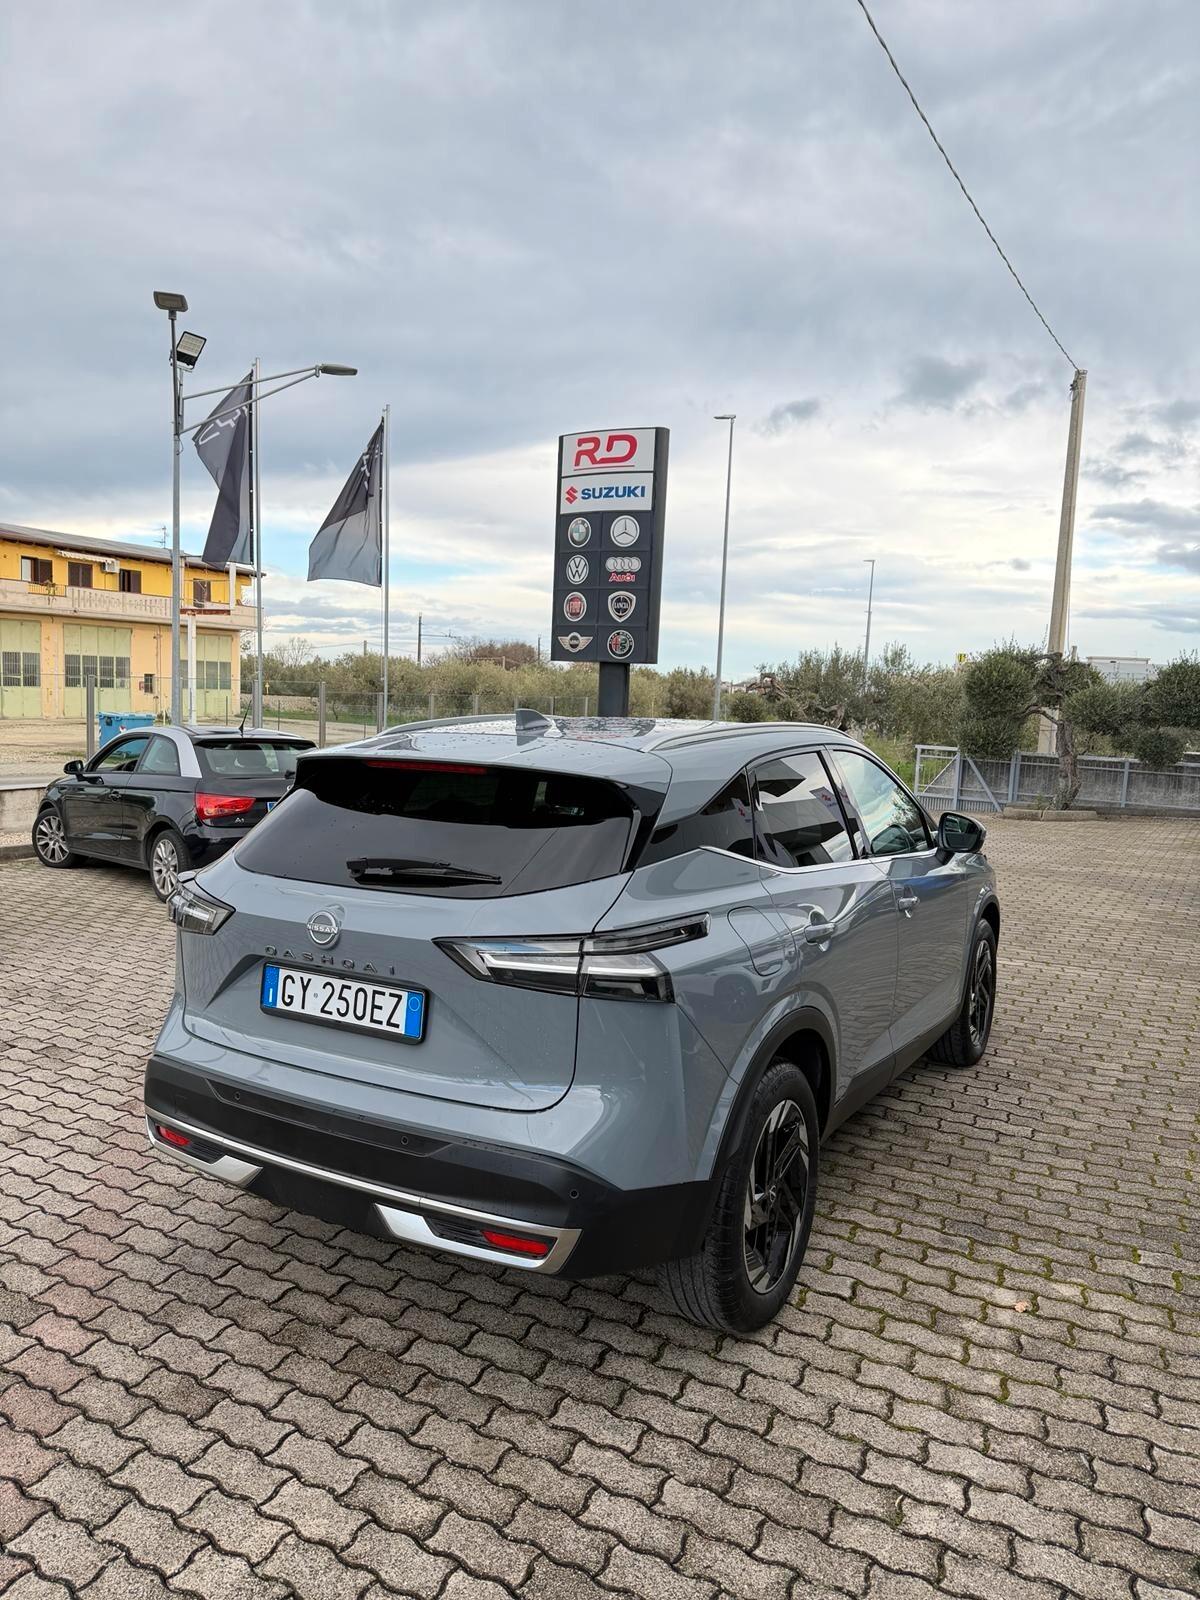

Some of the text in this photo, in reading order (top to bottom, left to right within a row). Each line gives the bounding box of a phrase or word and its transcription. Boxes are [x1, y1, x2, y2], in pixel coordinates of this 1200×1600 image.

[574, 434, 638, 467] RD
[581, 486, 646, 500] SUZUKI
[608, 572, 636, 582] Audi
[306, 923, 338, 934] NISSAN
[265, 945, 395, 976] QASHQAI
[281, 974, 403, 1029] GY 250EZ
